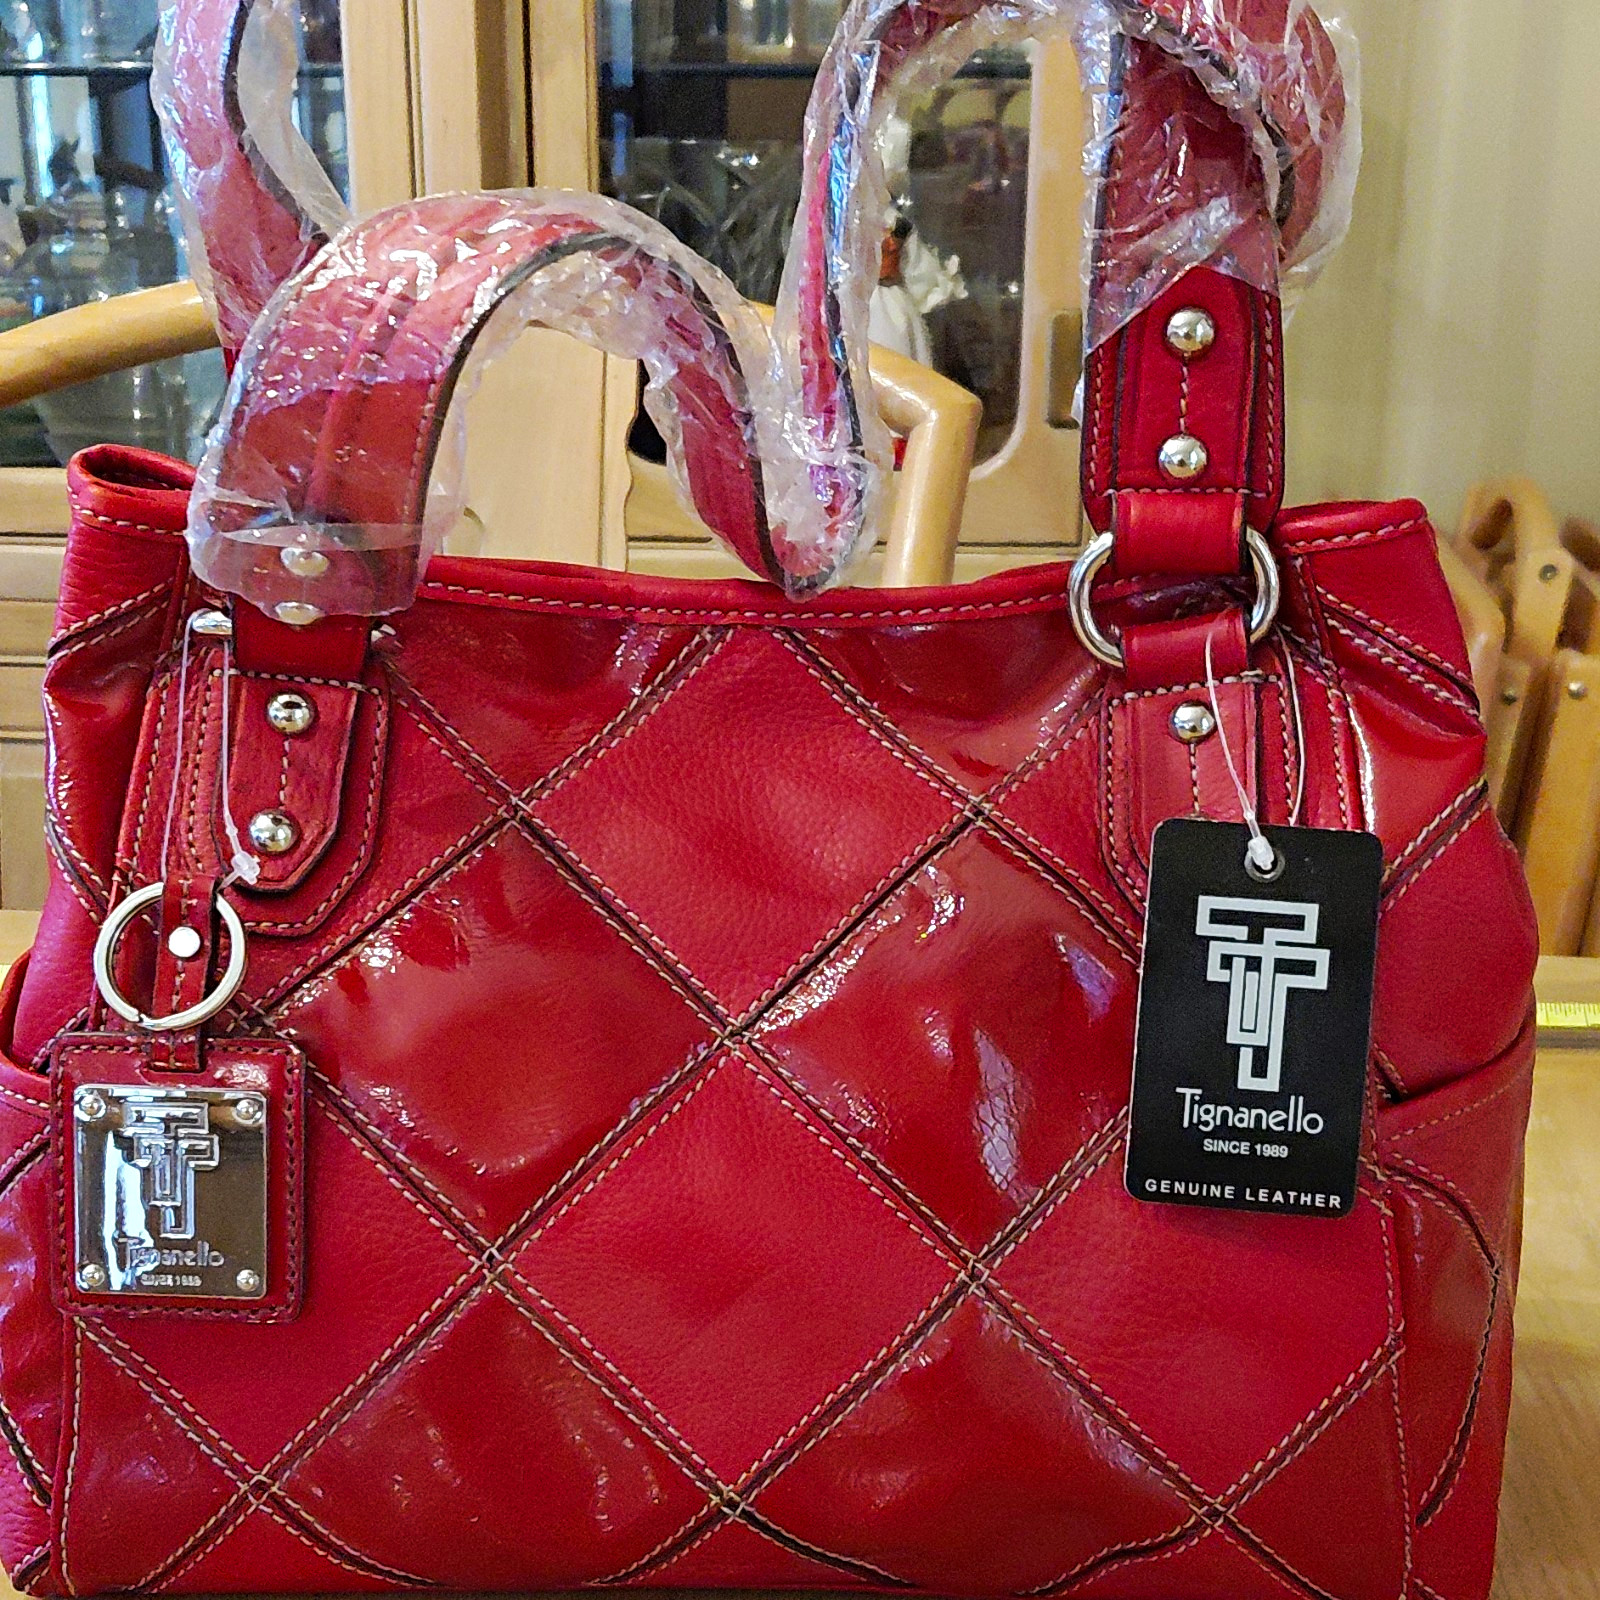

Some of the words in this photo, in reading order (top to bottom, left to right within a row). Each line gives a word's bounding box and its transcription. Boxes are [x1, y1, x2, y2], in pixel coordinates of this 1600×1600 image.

[1175, 1086, 1324, 1134] Tignanello
[1203, 1138, 1250, 1155] SINCE
[1255, 1143, 1289, 1158] 1989
[1145, 1178, 1235, 1199] GENUINE
[1245, 1187, 1341, 1209] LEATHER
